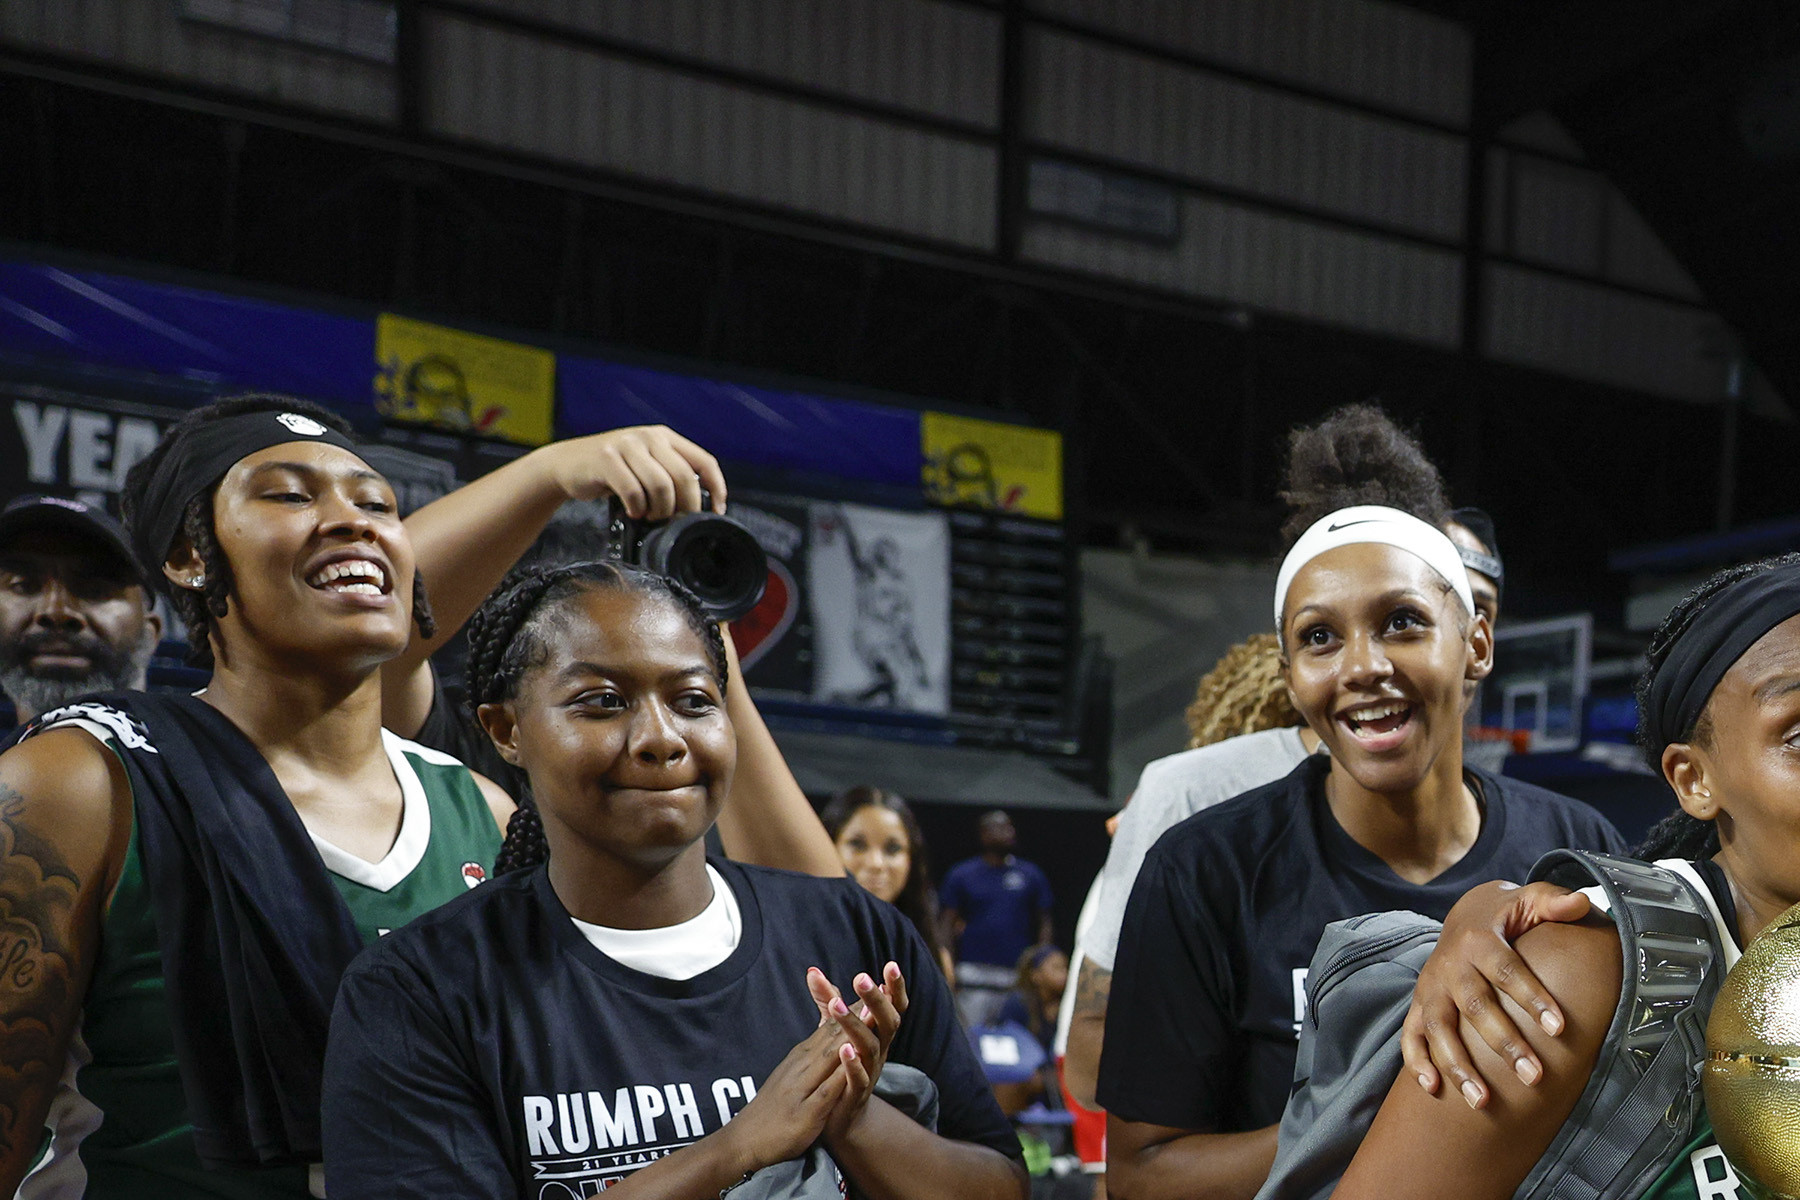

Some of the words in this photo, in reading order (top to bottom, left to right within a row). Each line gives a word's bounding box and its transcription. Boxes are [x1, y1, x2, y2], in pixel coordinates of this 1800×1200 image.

[523, 1083, 705, 1156] RUMPH
[582, 1160, 601, 1170] 21
[612, 1149, 671, 1166] YEARS
